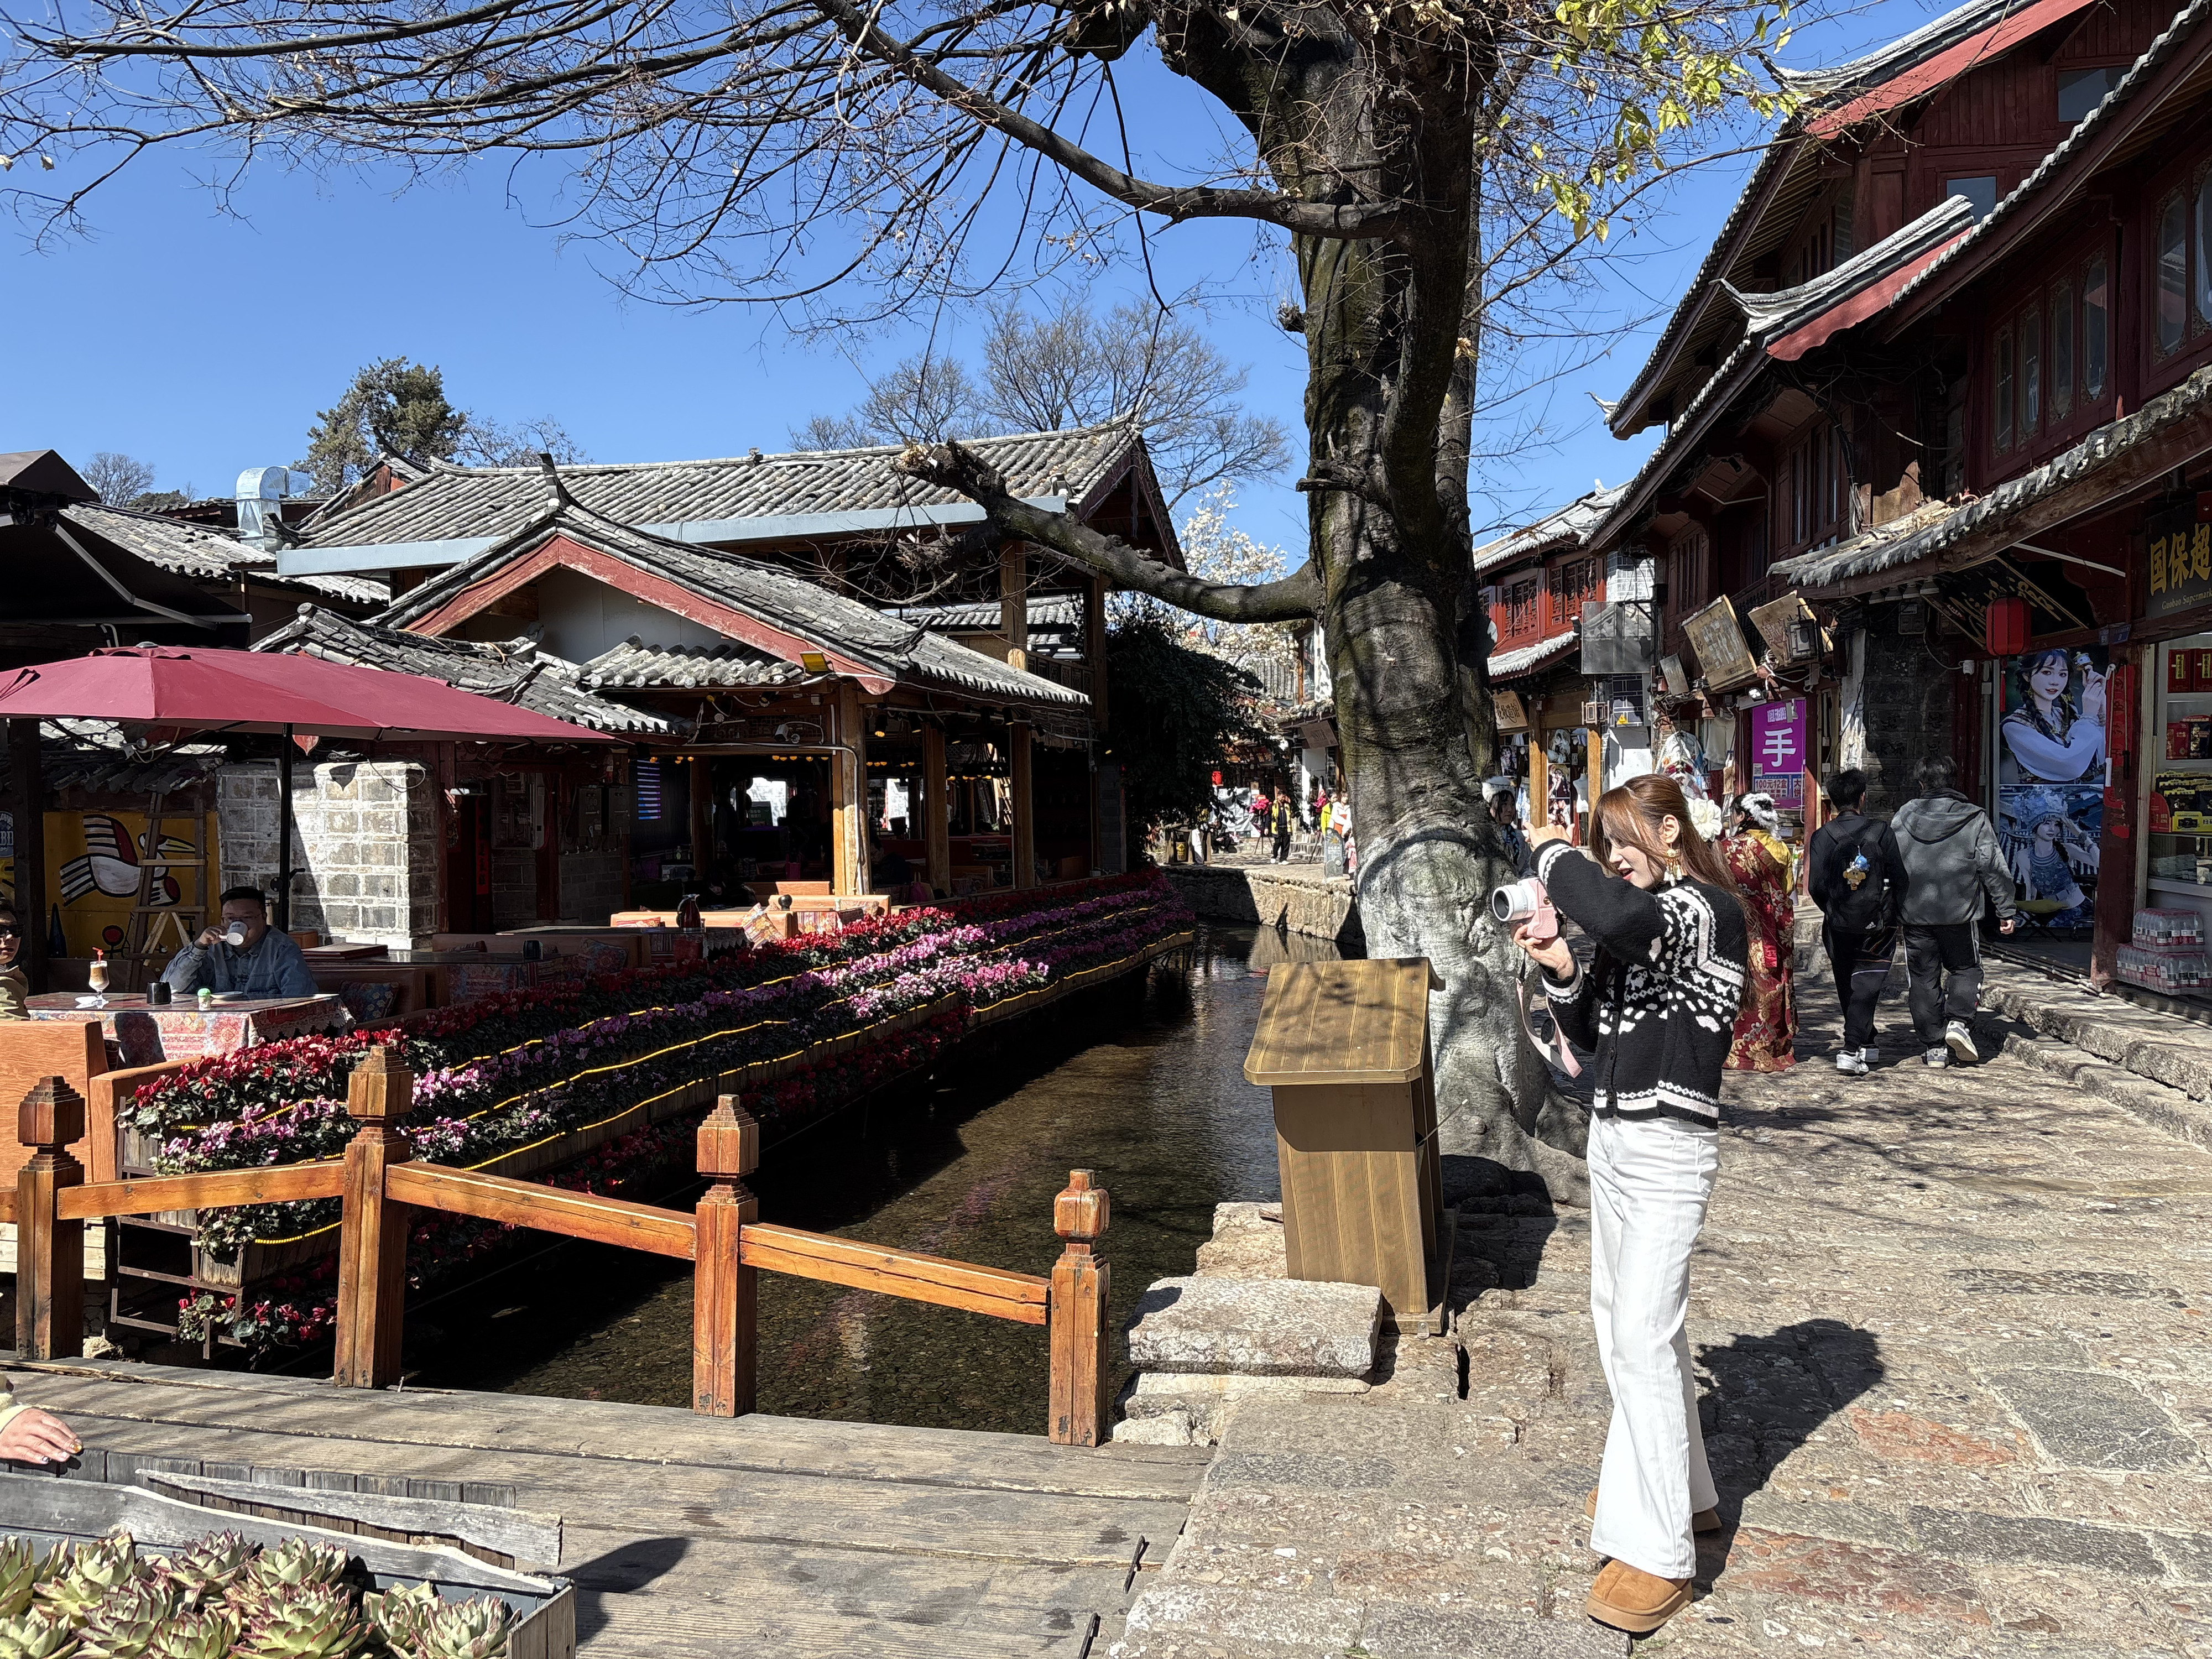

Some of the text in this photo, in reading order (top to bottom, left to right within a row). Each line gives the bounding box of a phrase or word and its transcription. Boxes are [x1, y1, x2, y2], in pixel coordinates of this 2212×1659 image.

[2150, 523, 2212, 597] 国保超
[2162, 598, 2182, 610] Guobao
[1762, 727, 1796, 767] 手
